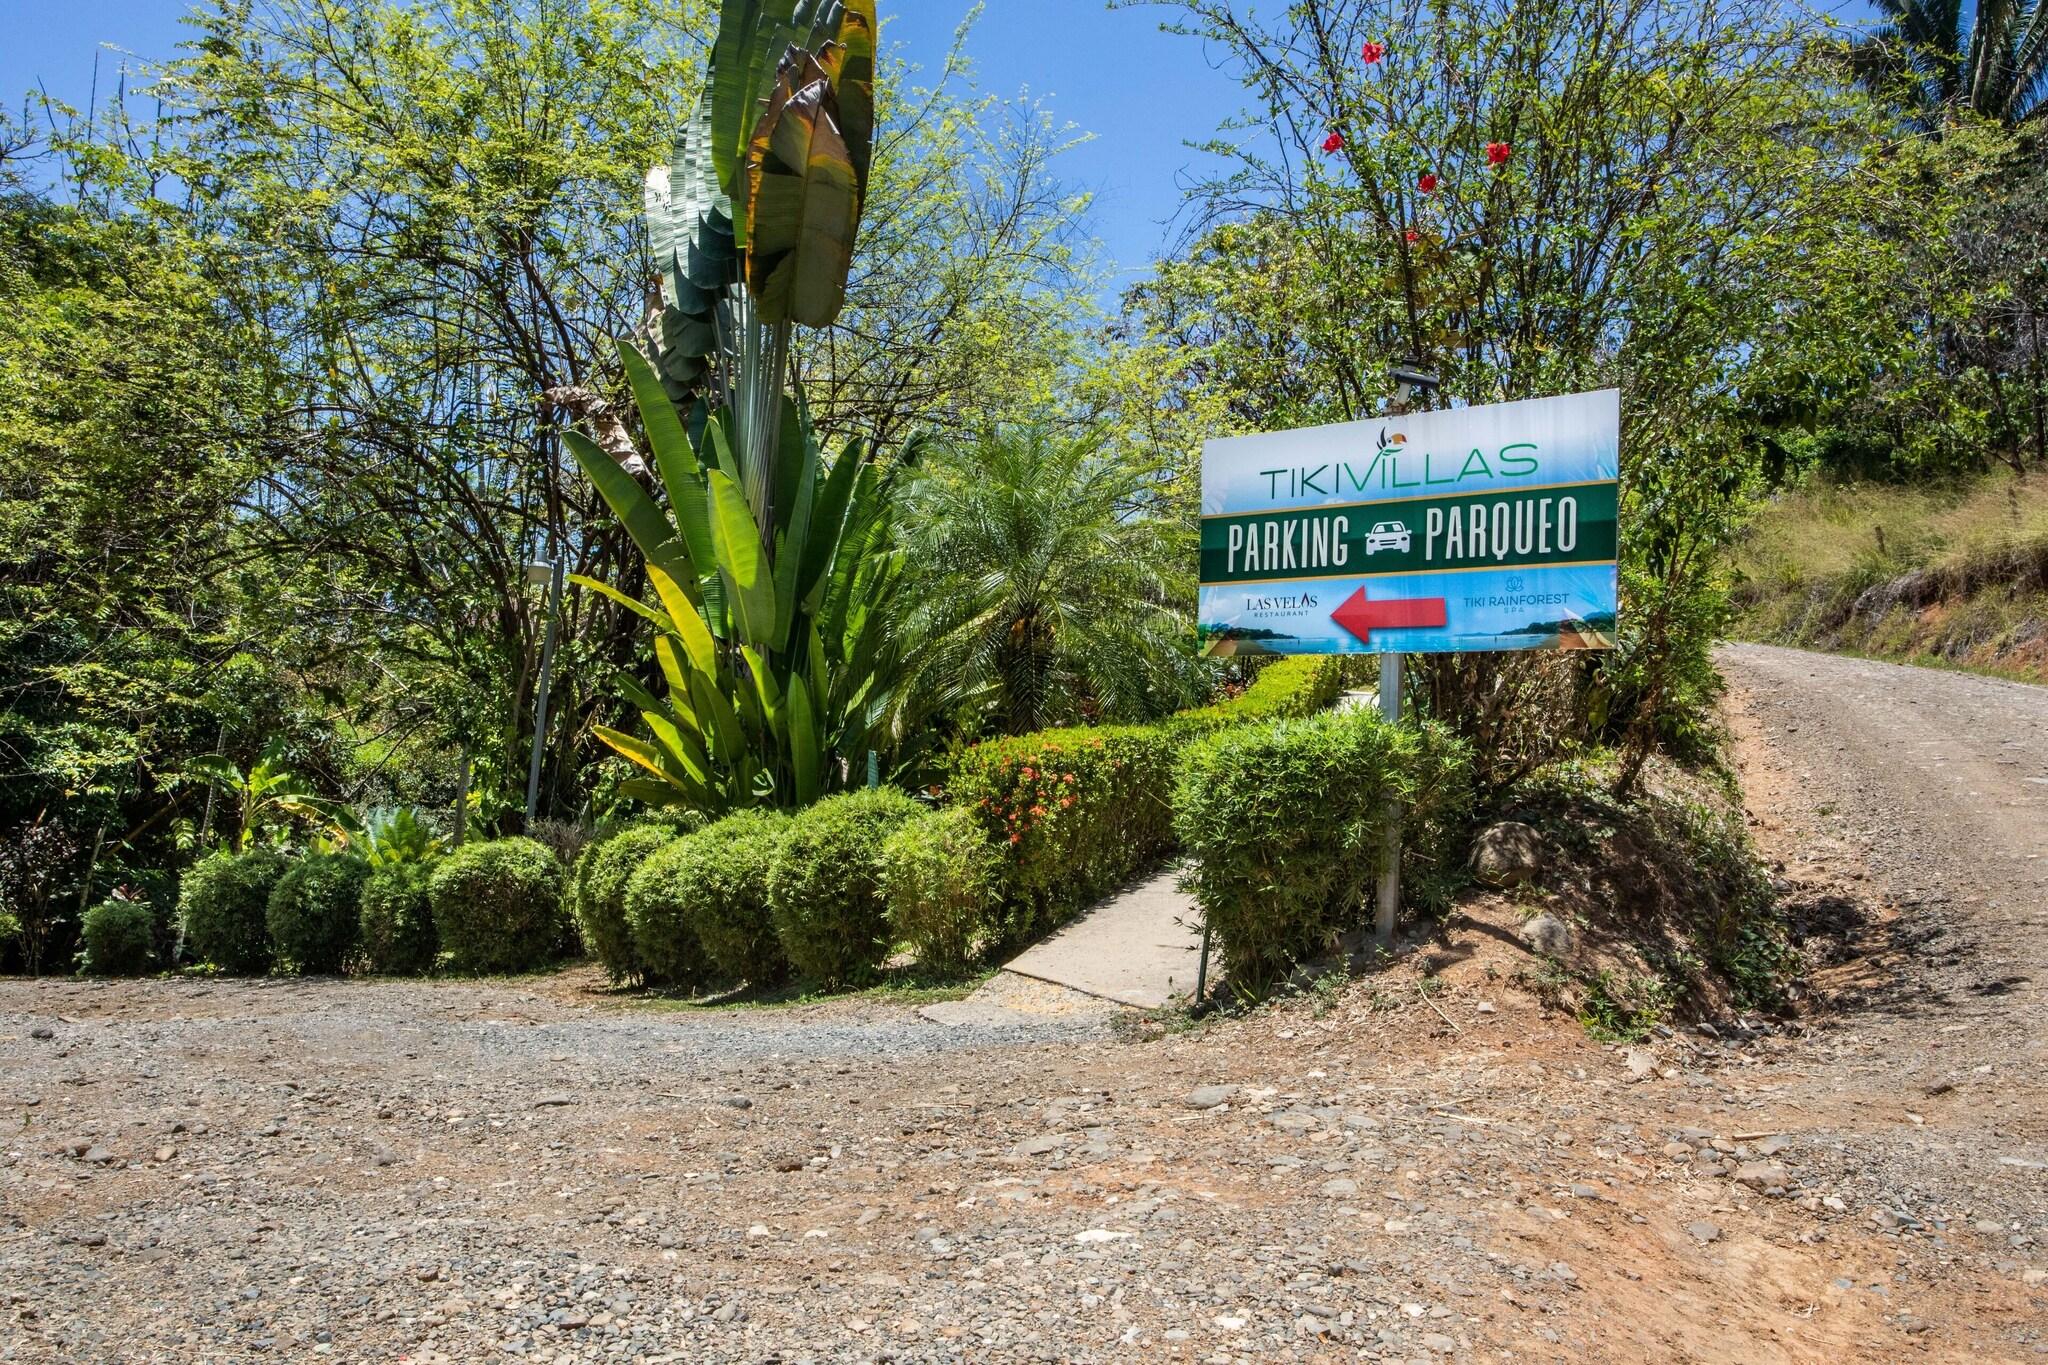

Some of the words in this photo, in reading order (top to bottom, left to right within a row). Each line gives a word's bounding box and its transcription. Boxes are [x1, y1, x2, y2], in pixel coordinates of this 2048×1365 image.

[1227, 515, 1349, 573] PARKING
[1425, 497, 1577, 561] PARQUEO
[1247, 597, 1271, 611] LAS
[1273, 591, 1318, 609] VELAS
[1463, 596, 1486, 608] TIKI
[1488, 592, 1570, 607] RAINFOREST
[1254, 610, 1309, 618] RESTAURANT
